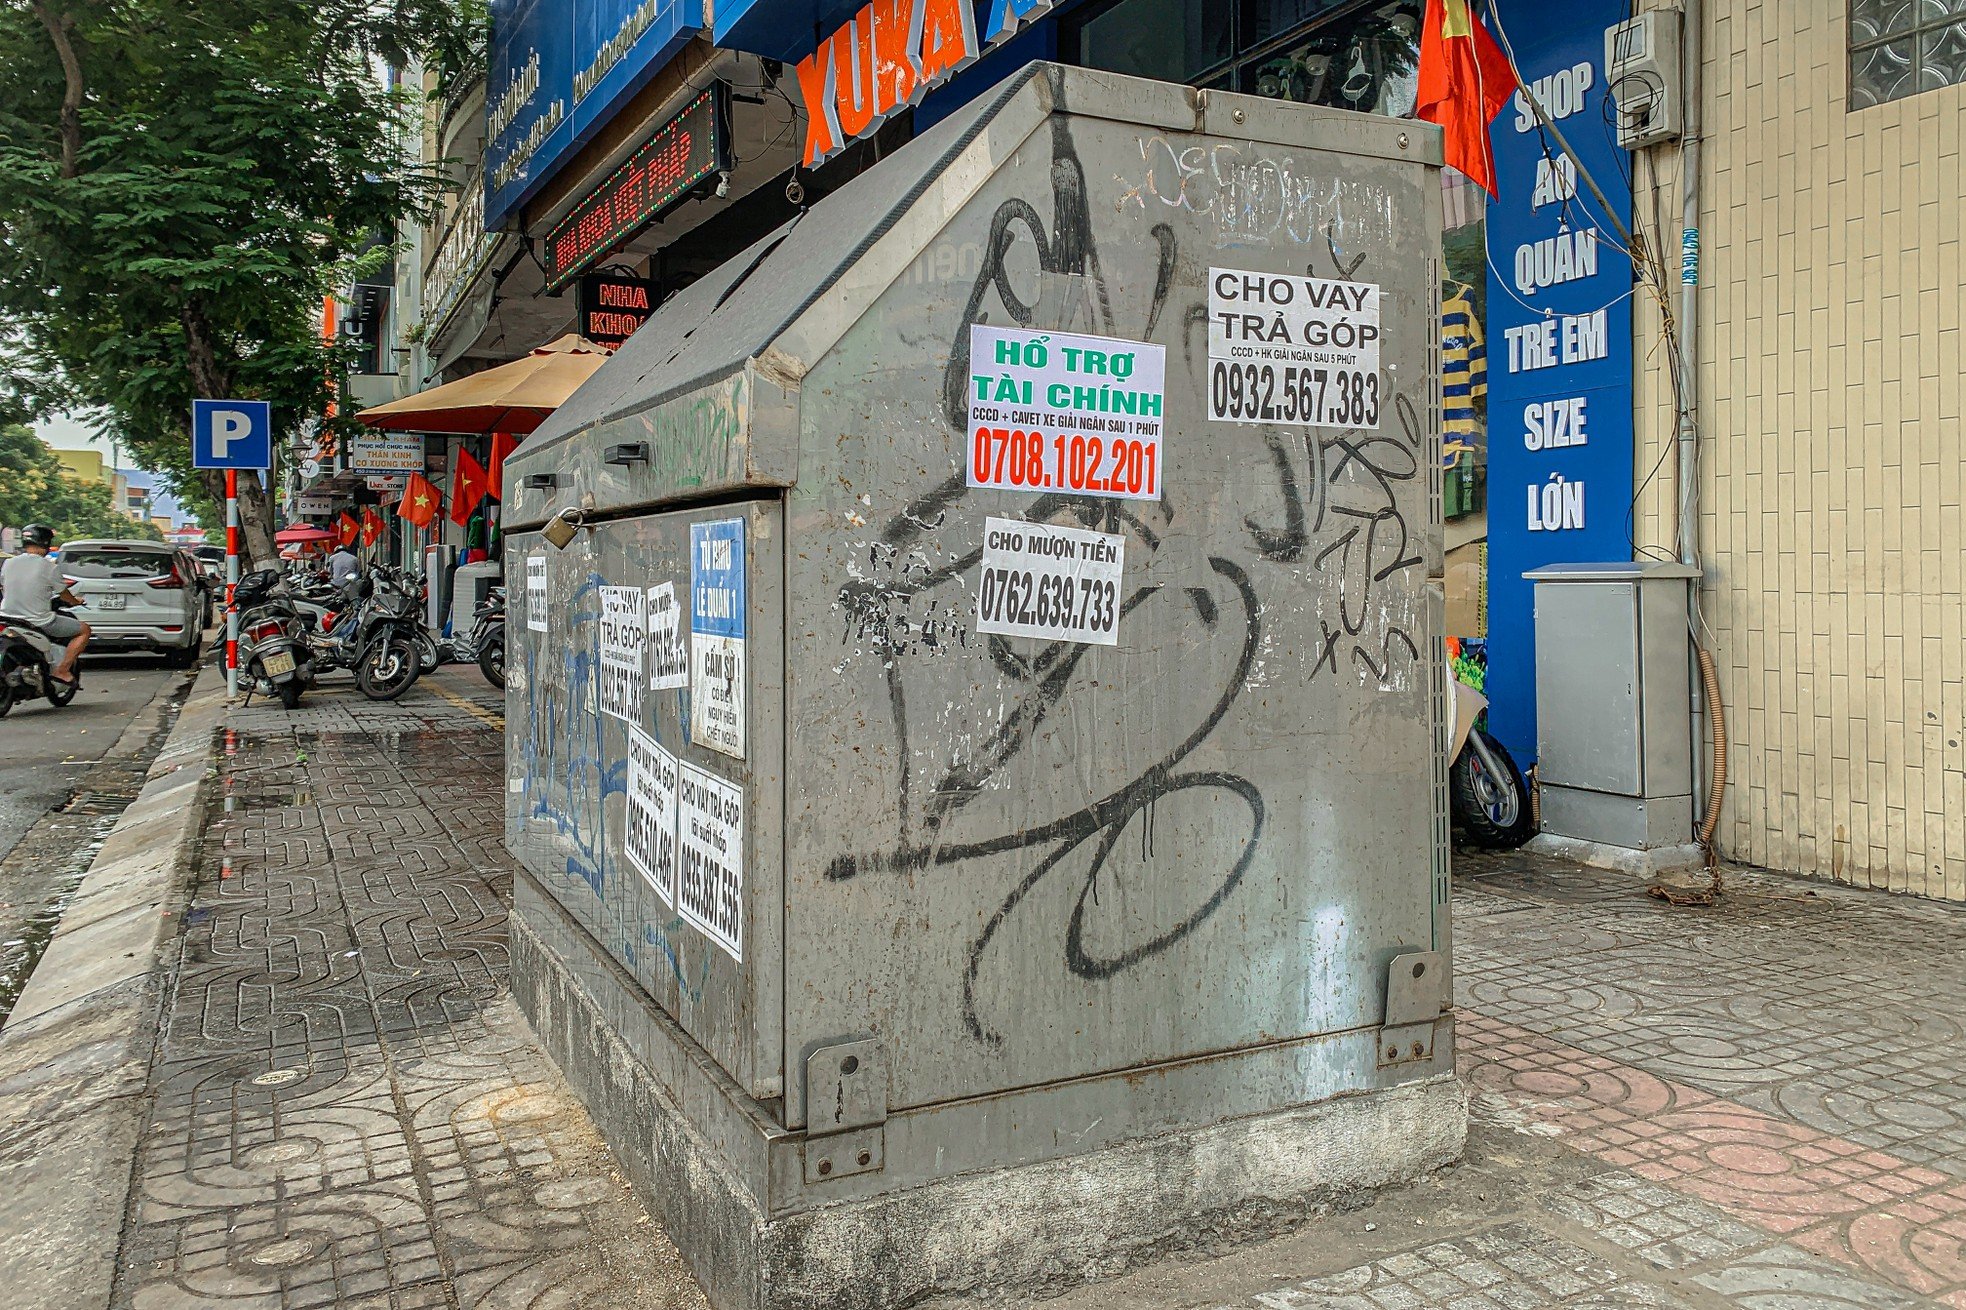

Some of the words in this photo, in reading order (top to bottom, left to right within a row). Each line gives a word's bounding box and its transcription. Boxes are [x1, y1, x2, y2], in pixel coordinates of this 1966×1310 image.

[796, 0, 972, 168] XUKA
[1515, 62, 1594, 133] SHOP
[556, 227, 578, 272] NHA
[579, 199, 612, 253] KHOA
[614, 164, 645, 223] VIỆT
[648, 126, 691, 200] PHÁP
[1515, 216, 1598, 295] QUẦN
[600, 284, 648, 309] NHA
[1215, 273, 1294, 305] CHO
[1305, 282, 1370, 312] VAY
[1217, 310, 1292, 344] TRẢ
[1303, 317, 1379, 349] GÓP
[1504, 307, 1558, 373] TRẺ
[1562, 309, 1608, 364] EM
[1061, 347, 1135, 382] TRỢ
[1231, 346, 1253, 358] CCCD
[1261, 348, 1273, 359] HK
[1274, 347, 1289, 361] GIẢI
[1291, 348, 1312, 362] NGÂN
[1314, 352, 1329, 363] SAU
[1331, 354, 1335, 364] 5
[1337, 352, 1356, 365] PHÚT
[972, 372, 1034, 405] TÀI
[1046, 383, 1162, 417] CHÍNH
[1213, 361, 1379, 425] 0932.567.383
[211, 410, 252, 459] P
[972, 407, 999, 422] CCCD
[1011, 410, 1041, 425] CAVET
[1043, 413, 1055, 427] XE
[1058, 411, 1077, 429] GIẢI
[1079, 415, 1106, 432] NGÂN
[1108, 421, 1126, 433] SAU
[1128, 422, 1133, 434] 1
[1136, 420, 1160, 436] PHÚT
[1524, 397, 1588, 452] SIZE
[973, 426, 1157, 494] 0708.102.201
[1527, 471, 1585, 531] LỚN
[988, 531, 1023, 552] CHO
[1028, 535, 1075, 560] MƯỢN
[1080, 537, 1117, 563] TIỀN
[620, 590, 639, 615] VAY
[732, 588, 736, 620] 1
[981, 567, 1116, 633] 0762.639.733
[602, 618, 619, 646] TRẢ
[621, 620, 642, 653] GÓP
[704, 645, 722, 679] CẤM
[706, 724, 721, 741] CHẾT
[708, 706, 723, 723] NGUY
[630, 736, 641, 764] CHO
[642, 746, 651, 774] VAY
[652, 753, 661, 784] TRẢ
[662, 763, 675, 794] GÓP
[681, 777, 695, 806] CHO
[696, 785, 709, 814] VAY
[709, 786, 722, 822] TRẢ
[724, 795, 740, 830] GÓP
[681, 842, 739, 943] 0935.887.556
